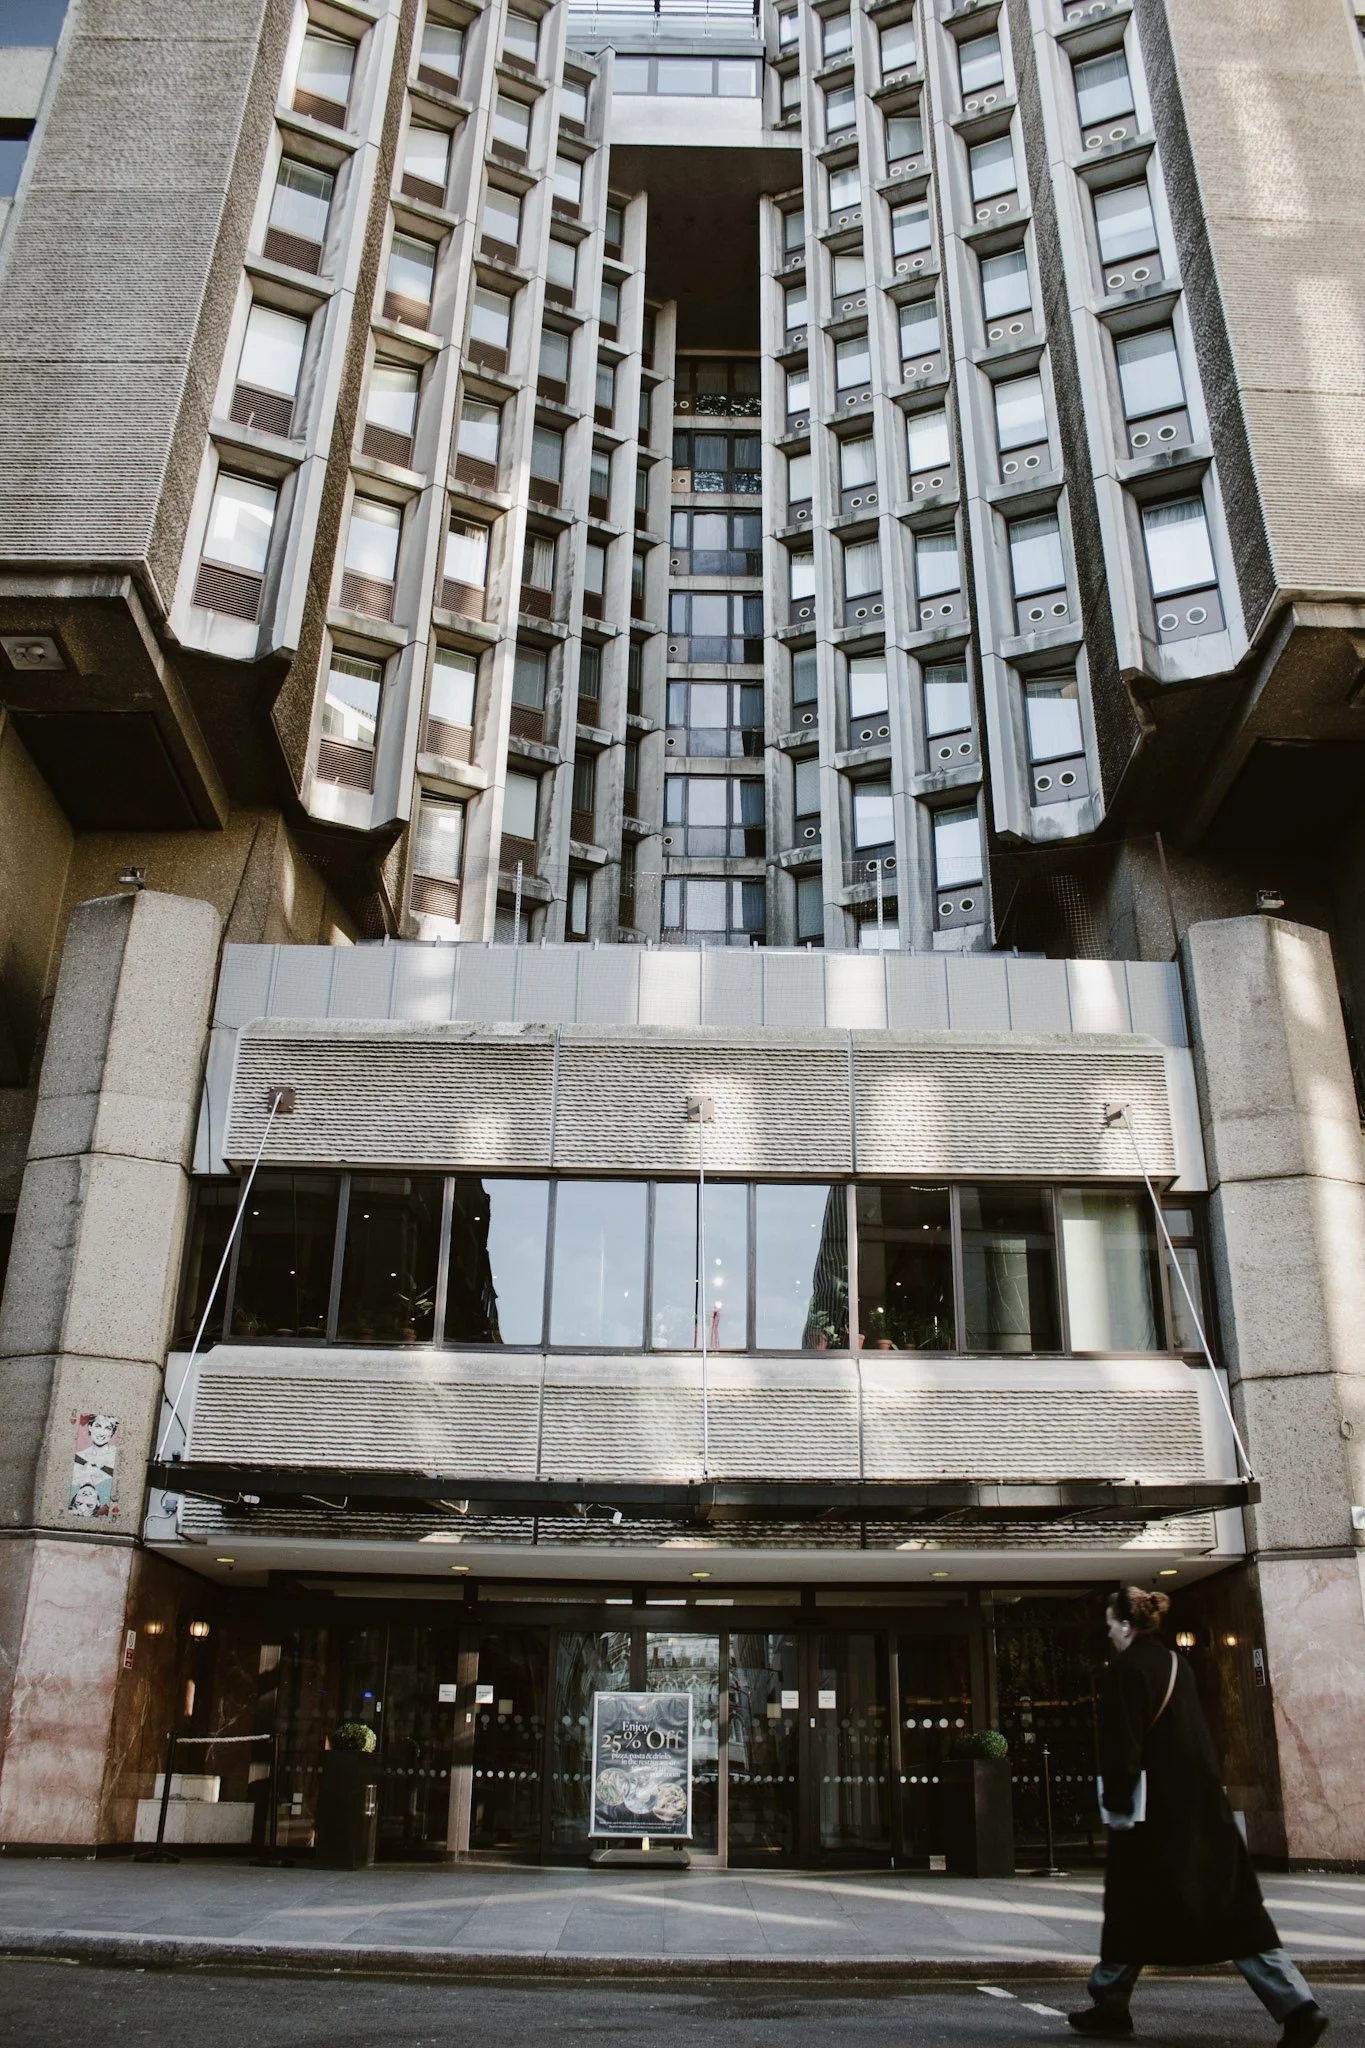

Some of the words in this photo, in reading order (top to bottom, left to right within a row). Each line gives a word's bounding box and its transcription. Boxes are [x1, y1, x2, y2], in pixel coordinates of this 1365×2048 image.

[622, 1721, 650, 1734] Enjoy
[601, 1731, 641, 1753] 25%
[646, 1730, 684, 1750] Off
[653, 1752, 672, 1760] drinks
